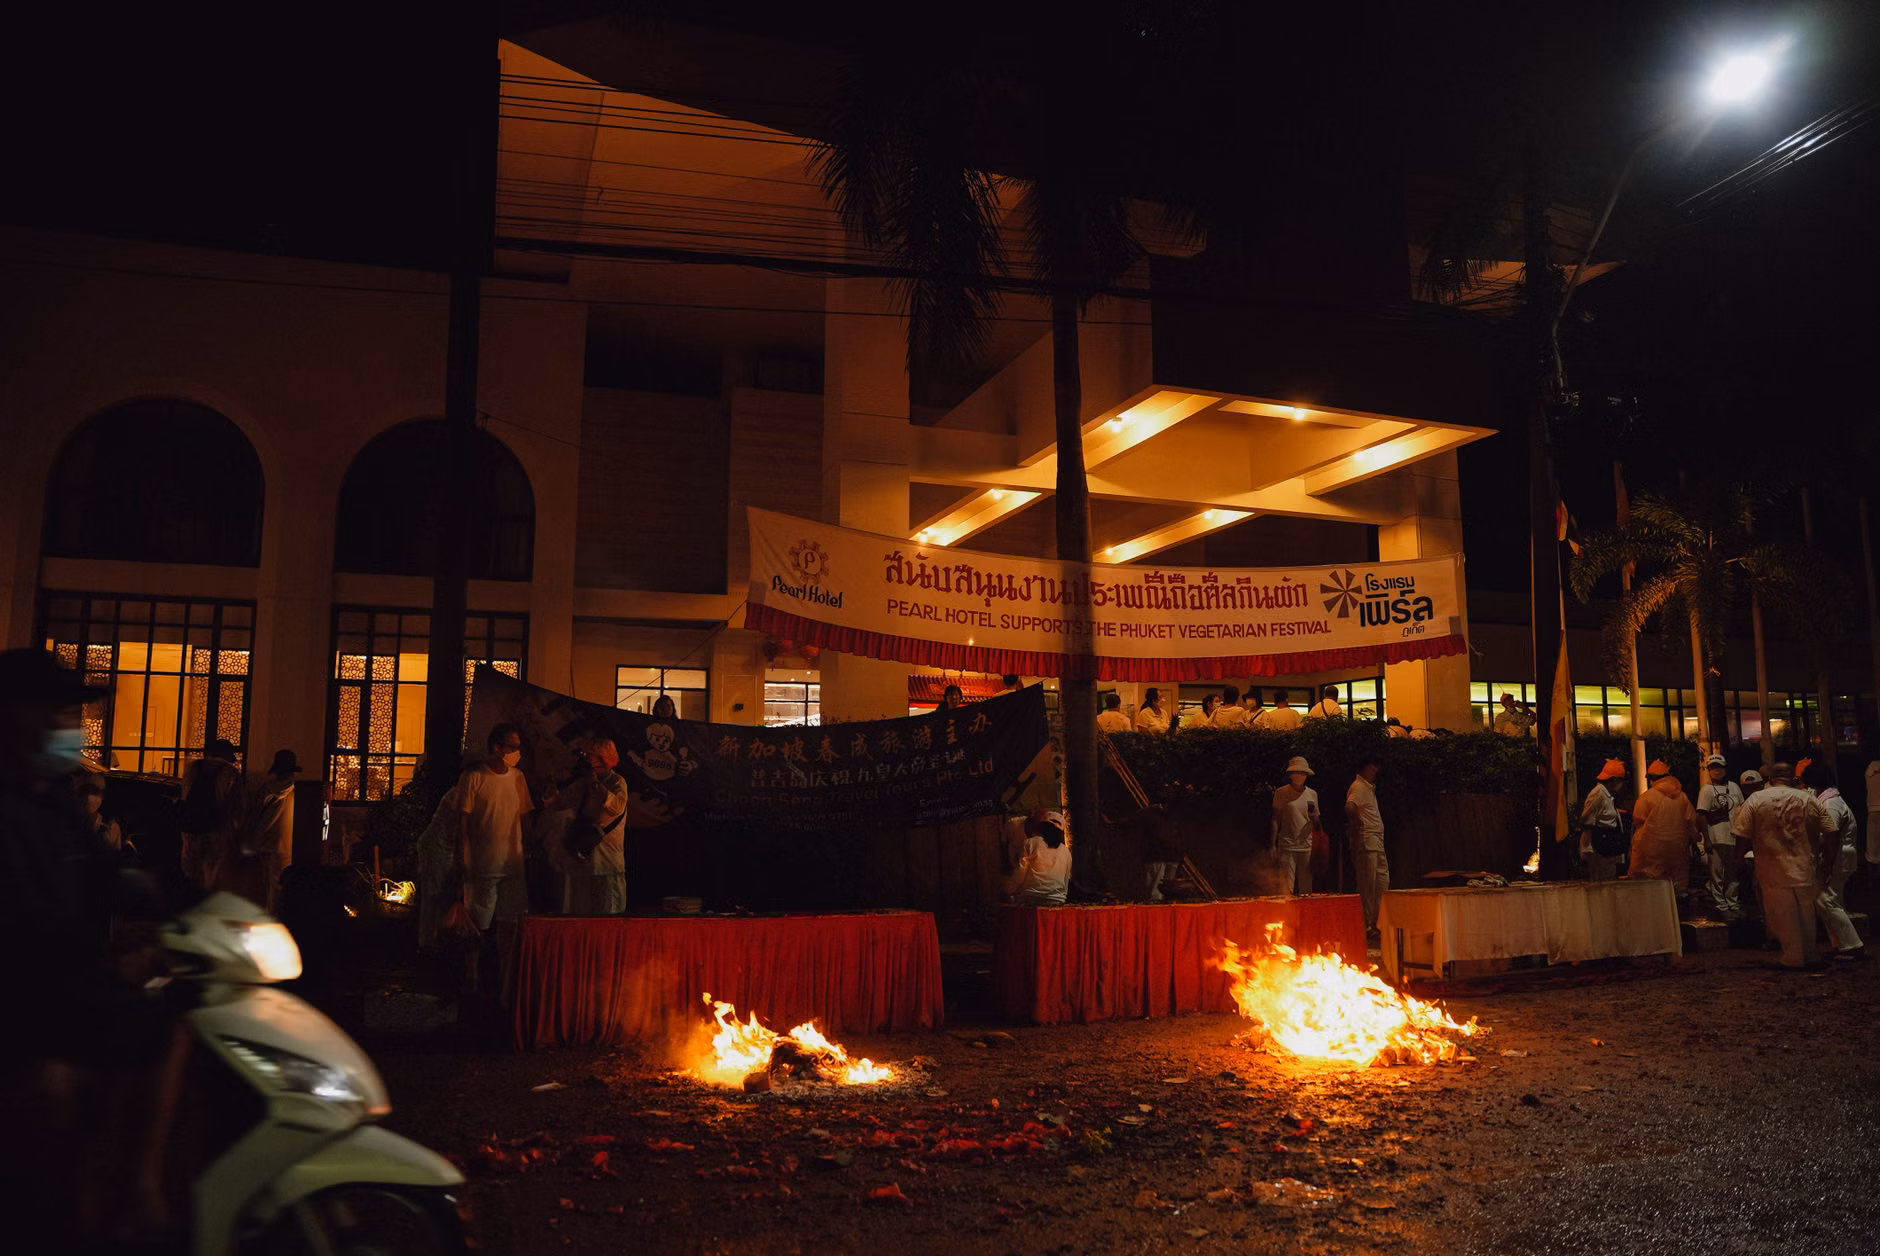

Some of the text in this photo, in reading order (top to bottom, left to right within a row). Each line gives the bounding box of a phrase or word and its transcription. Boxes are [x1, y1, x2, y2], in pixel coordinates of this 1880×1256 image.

[772, 576, 843, 608] Pearl Hotel
[1365, 573, 1415, 591] โรงแรม
[887, 599, 1331, 639] PEARL HOTEL SUPPORTS THE PHUKET VEGETARIAN FESTIVAL
[1402, 622, 1425, 637] ภูเก็ต
